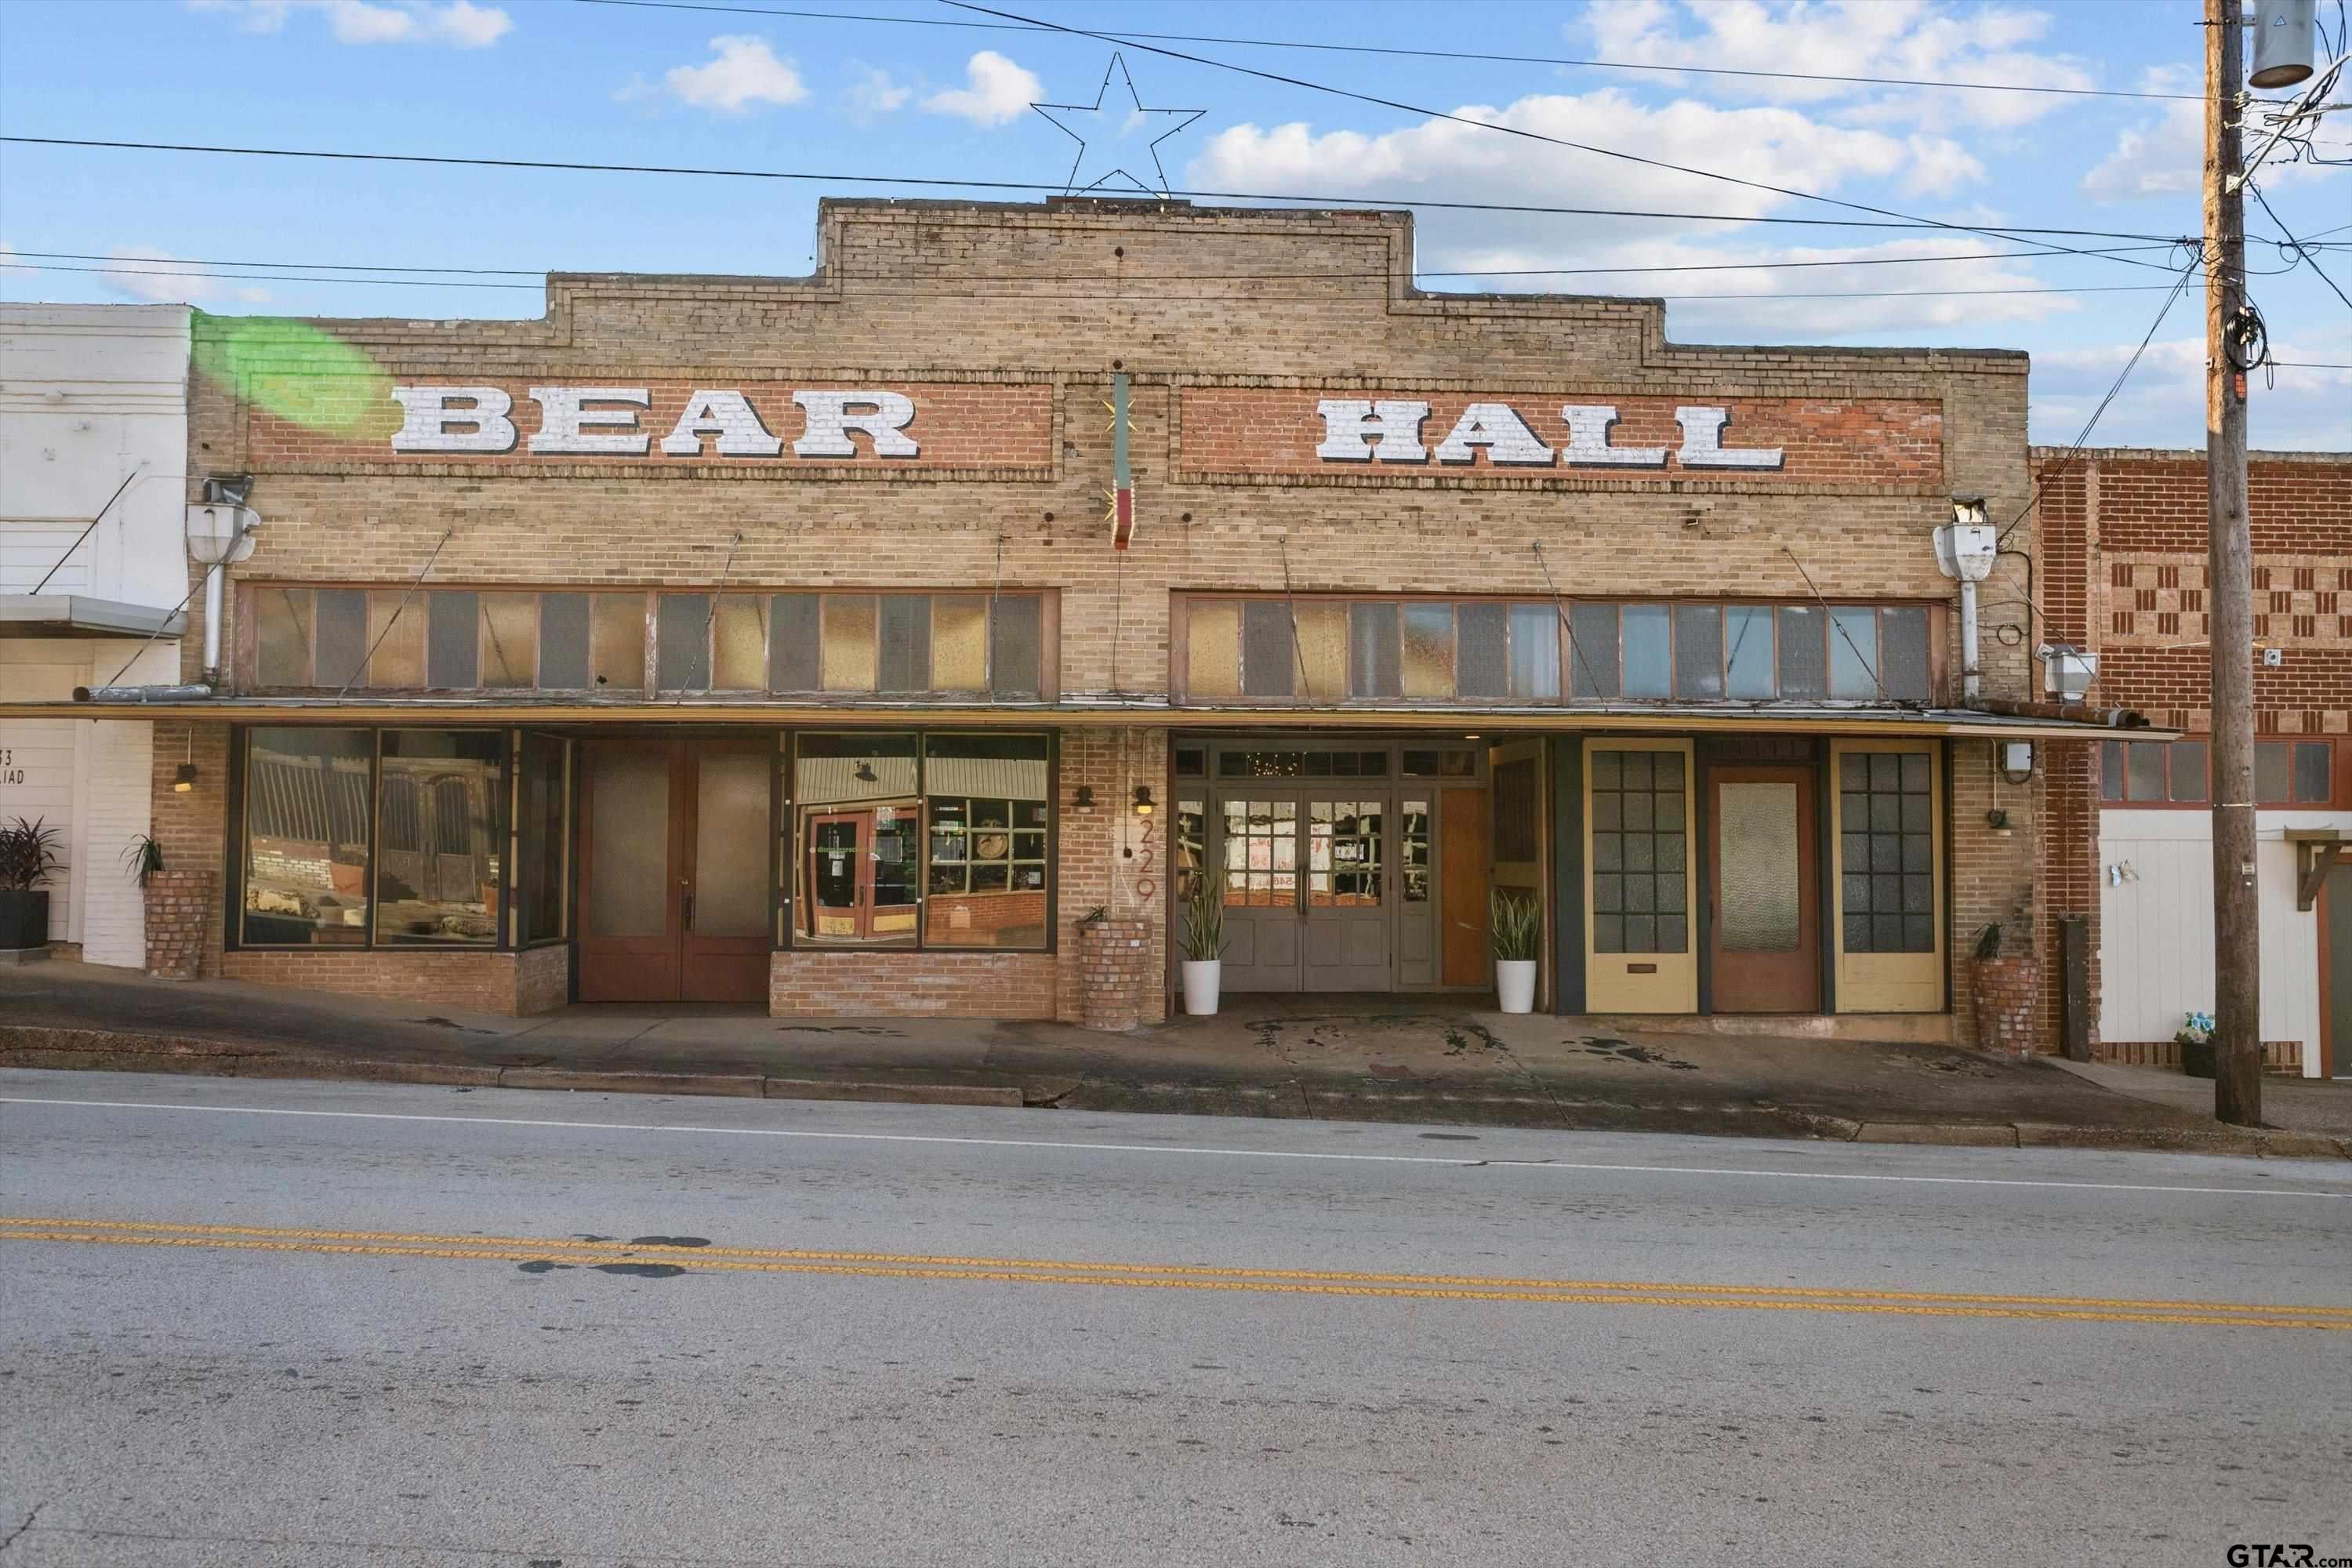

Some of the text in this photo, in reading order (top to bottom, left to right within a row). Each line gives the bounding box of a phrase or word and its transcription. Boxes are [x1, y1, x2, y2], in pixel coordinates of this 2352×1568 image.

[390, 386, 1784, 470] BEAR HALL
[0, 769, 24, 784] IAD
[1137, 818, 1156, 902] 229
